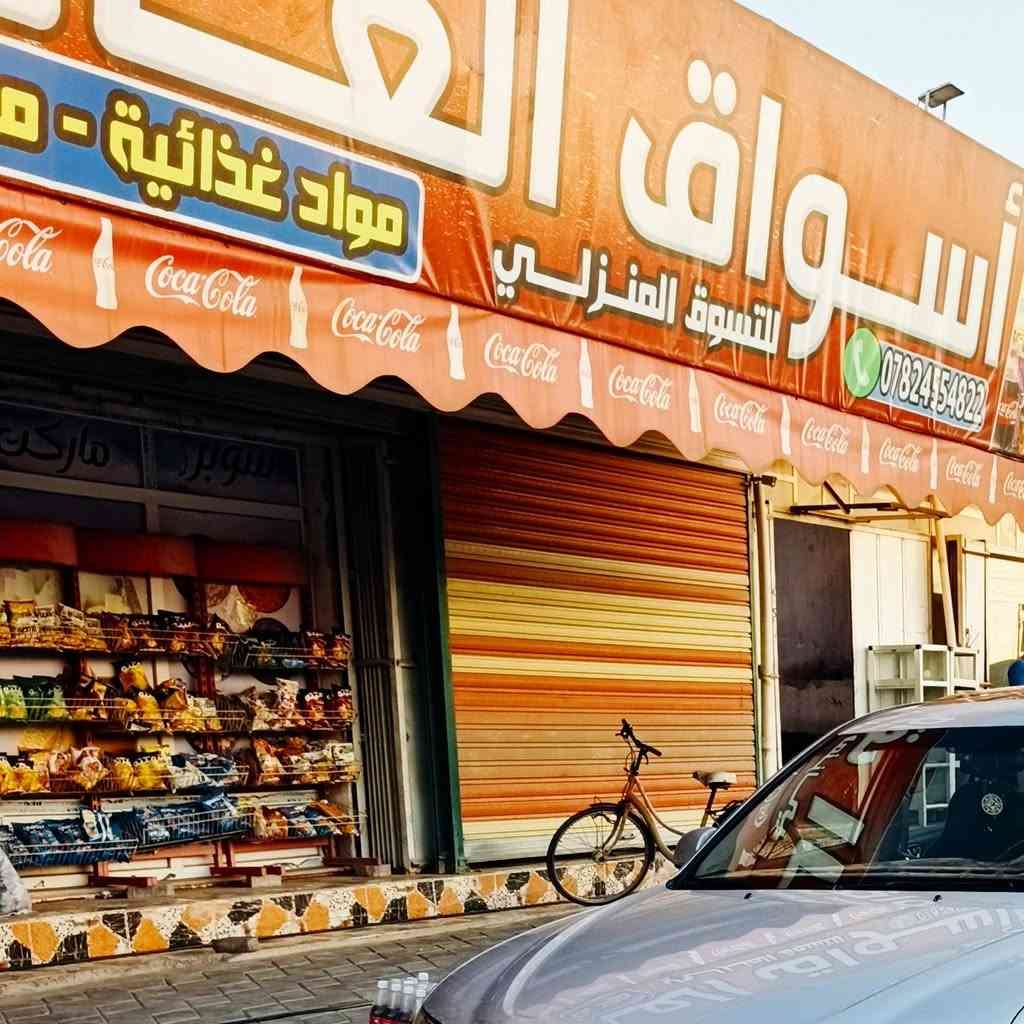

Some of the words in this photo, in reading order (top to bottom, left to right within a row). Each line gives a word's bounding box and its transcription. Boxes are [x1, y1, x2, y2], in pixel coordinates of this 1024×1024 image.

[109, 100, 283, 214] غذائية
[298, 171, 403, 250] مواد
[619, 59, 1024, 367] أسواق
[144, 254, 262, 319] Coca-Cola
[493, 244, 678, 324] المنزلي
[331, 297, 425, 352] Coca-Cola
[484, 333, 560, 384] Coca-Cola
[608, 364, 673, 410] Coca-Cola
